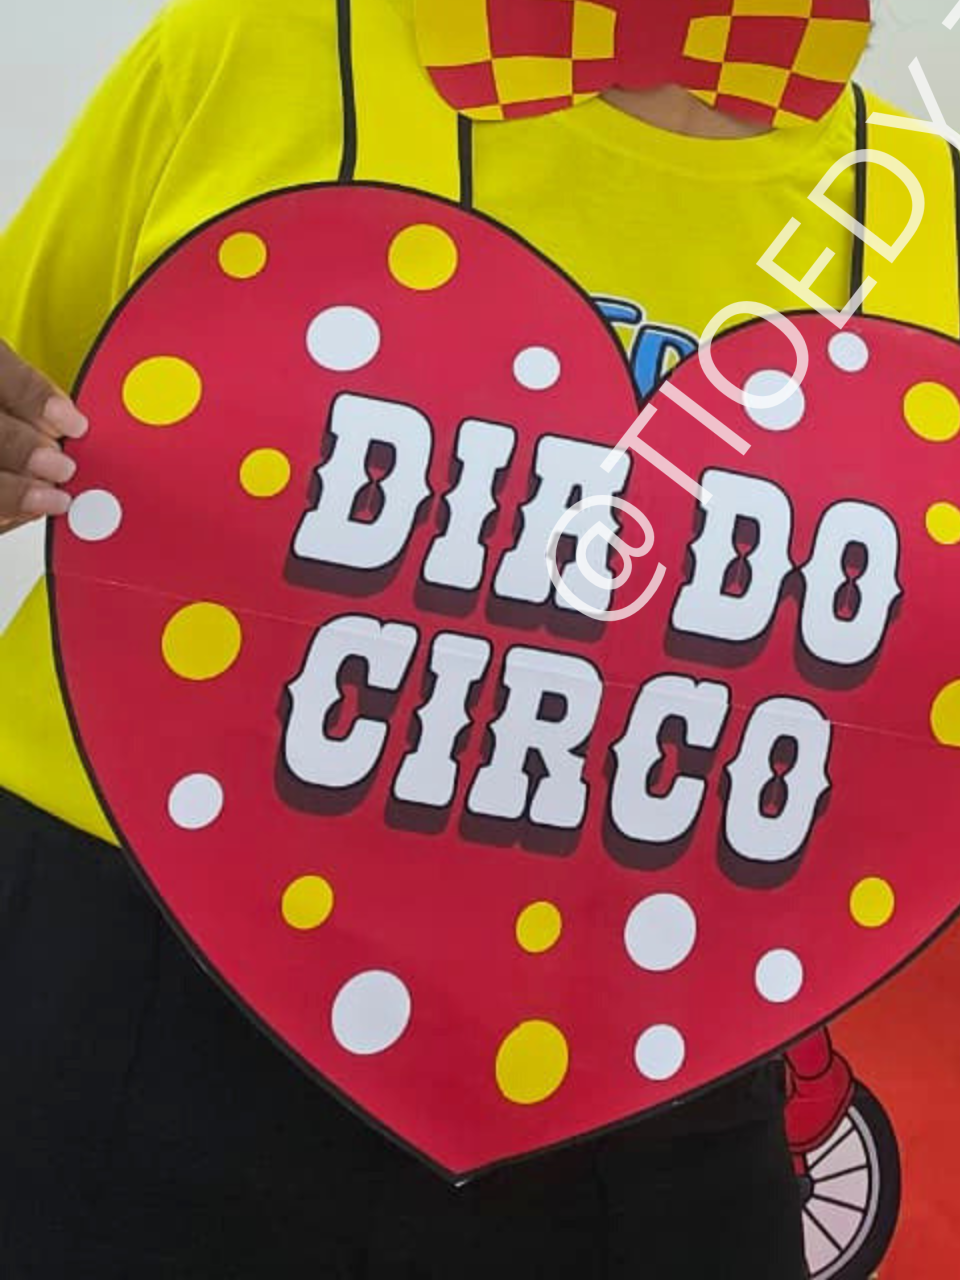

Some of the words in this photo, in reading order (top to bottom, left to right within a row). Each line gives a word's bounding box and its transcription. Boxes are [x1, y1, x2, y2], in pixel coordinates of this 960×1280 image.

[290, 390, 634, 615] DIA
[668, 465, 903, 667] DO
[283, 614, 834, 864] CIRCO
